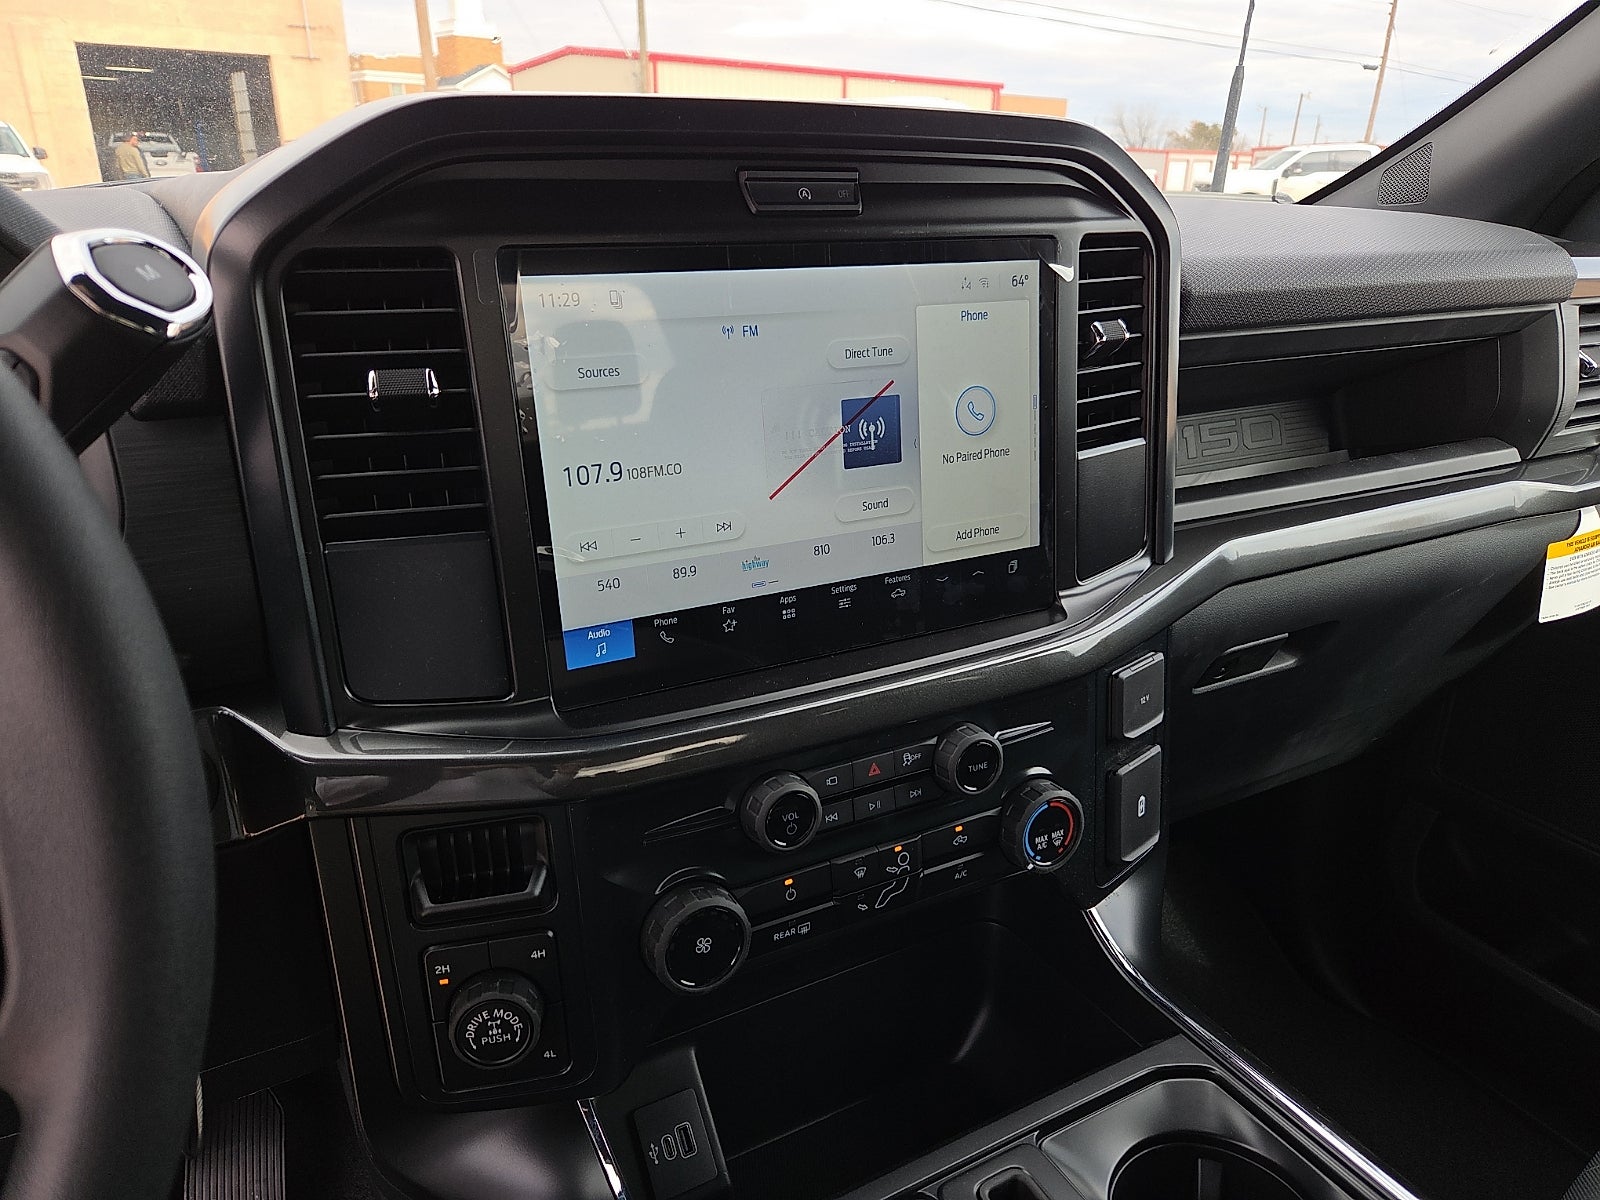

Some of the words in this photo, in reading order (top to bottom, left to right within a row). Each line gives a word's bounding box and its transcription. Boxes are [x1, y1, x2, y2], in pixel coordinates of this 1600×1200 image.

[538, 292, 581, 308] 11:29
[960, 310, 989, 322] Phone
[742, 325, 759, 337] FM
[845, 347, 870, 360] Direct
[872, 346, 893, 358] Tune
[577, 366, 620, 379] Sources
[1182, 414, 1282, 460] 150
[942, 453, 955, 465] No
[956, 450, 982, 463] Paired
[983, 446, 1010, 459] Phone
[563, 461, 623, 487] 107.9
[626, 462, 682, 480] 108FM.CO
[862, 498, 889, 511] Sound
[955, 528, 973, 541] Add
[974, 525, 1000, 537] Phone
[871, 533, 895, 546] 106.3
[813, 543, 831, 556] 810
[672, 565, 697, 579] 89.9
[597, 577, 621, 592] 540
[884, 573, 911, 584] Features
[831, 583, 857, 595] Settings
[779, 595, 797, 605] Apps
[722, 606, 736, 615] Fav
[654, 616, 678, 627] Phone
[587, 629, 611, 640] Audio
[911, 752, 922, 761] OFF
[968, 761, 988, 773] TUNE
[782, 812, 800, 823] VOL
[1035, 834, 1049, 845] MAX
[1051, 828, 1065, 839] MAX
[1037, 841, 1048, 851] A/C
[954, 868, 968, 880] A/C
[773, 927, 796, 941] REAR
[530, 949, 546, 959] 4H
[434, 964, 450, 975] 2H
[465, 1010, 490, 1039] DRIVE
[492, 1008, 524, 1031] MODE
[481, 1033, 512, 1046] PUSH
[543, 1050, 557, 1059] 4L
